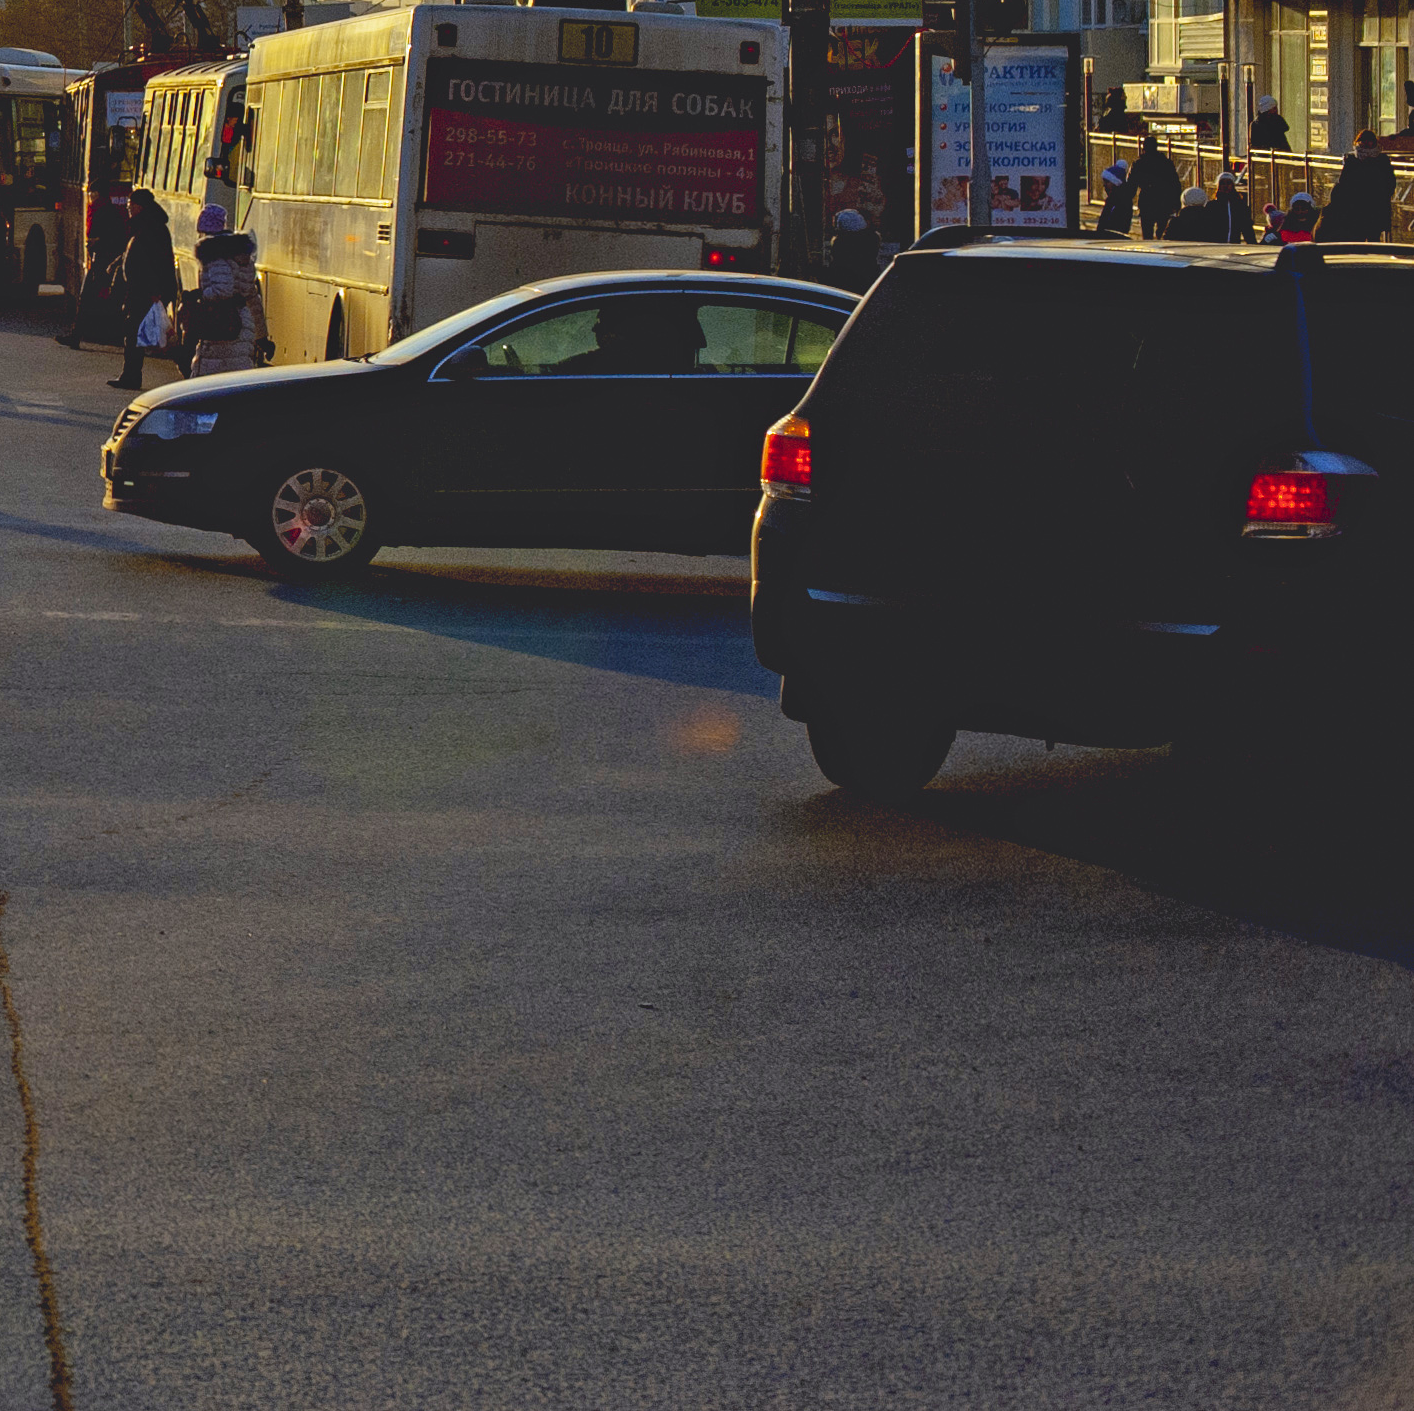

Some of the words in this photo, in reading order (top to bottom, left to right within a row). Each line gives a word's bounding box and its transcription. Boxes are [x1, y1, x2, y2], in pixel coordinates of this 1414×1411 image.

[580, 25, 614, 59] 10
[985, 66, 1057, 79] АКТИК
[448, 78, 596, 112] ГОСТИНИЦА
[607, 89, 659, 115] ДЛЯ
[672, 92, 754, 118] СОБАК
[954, 121, 1027, 132] УРЛОГИЯ
[446, 126, 538, 148] 298-55-73
[954, 141, 1057, 151] ЭСТИЧЕСКАЯ
[443, 151, 537, 171] 271-44-76
[957, 156, 1058, 167] ГИЕКОЛОГИЯ
[564, 183, 674, 210] КОННЫЙ
[682, 190, 747, 214] КЛУБ
